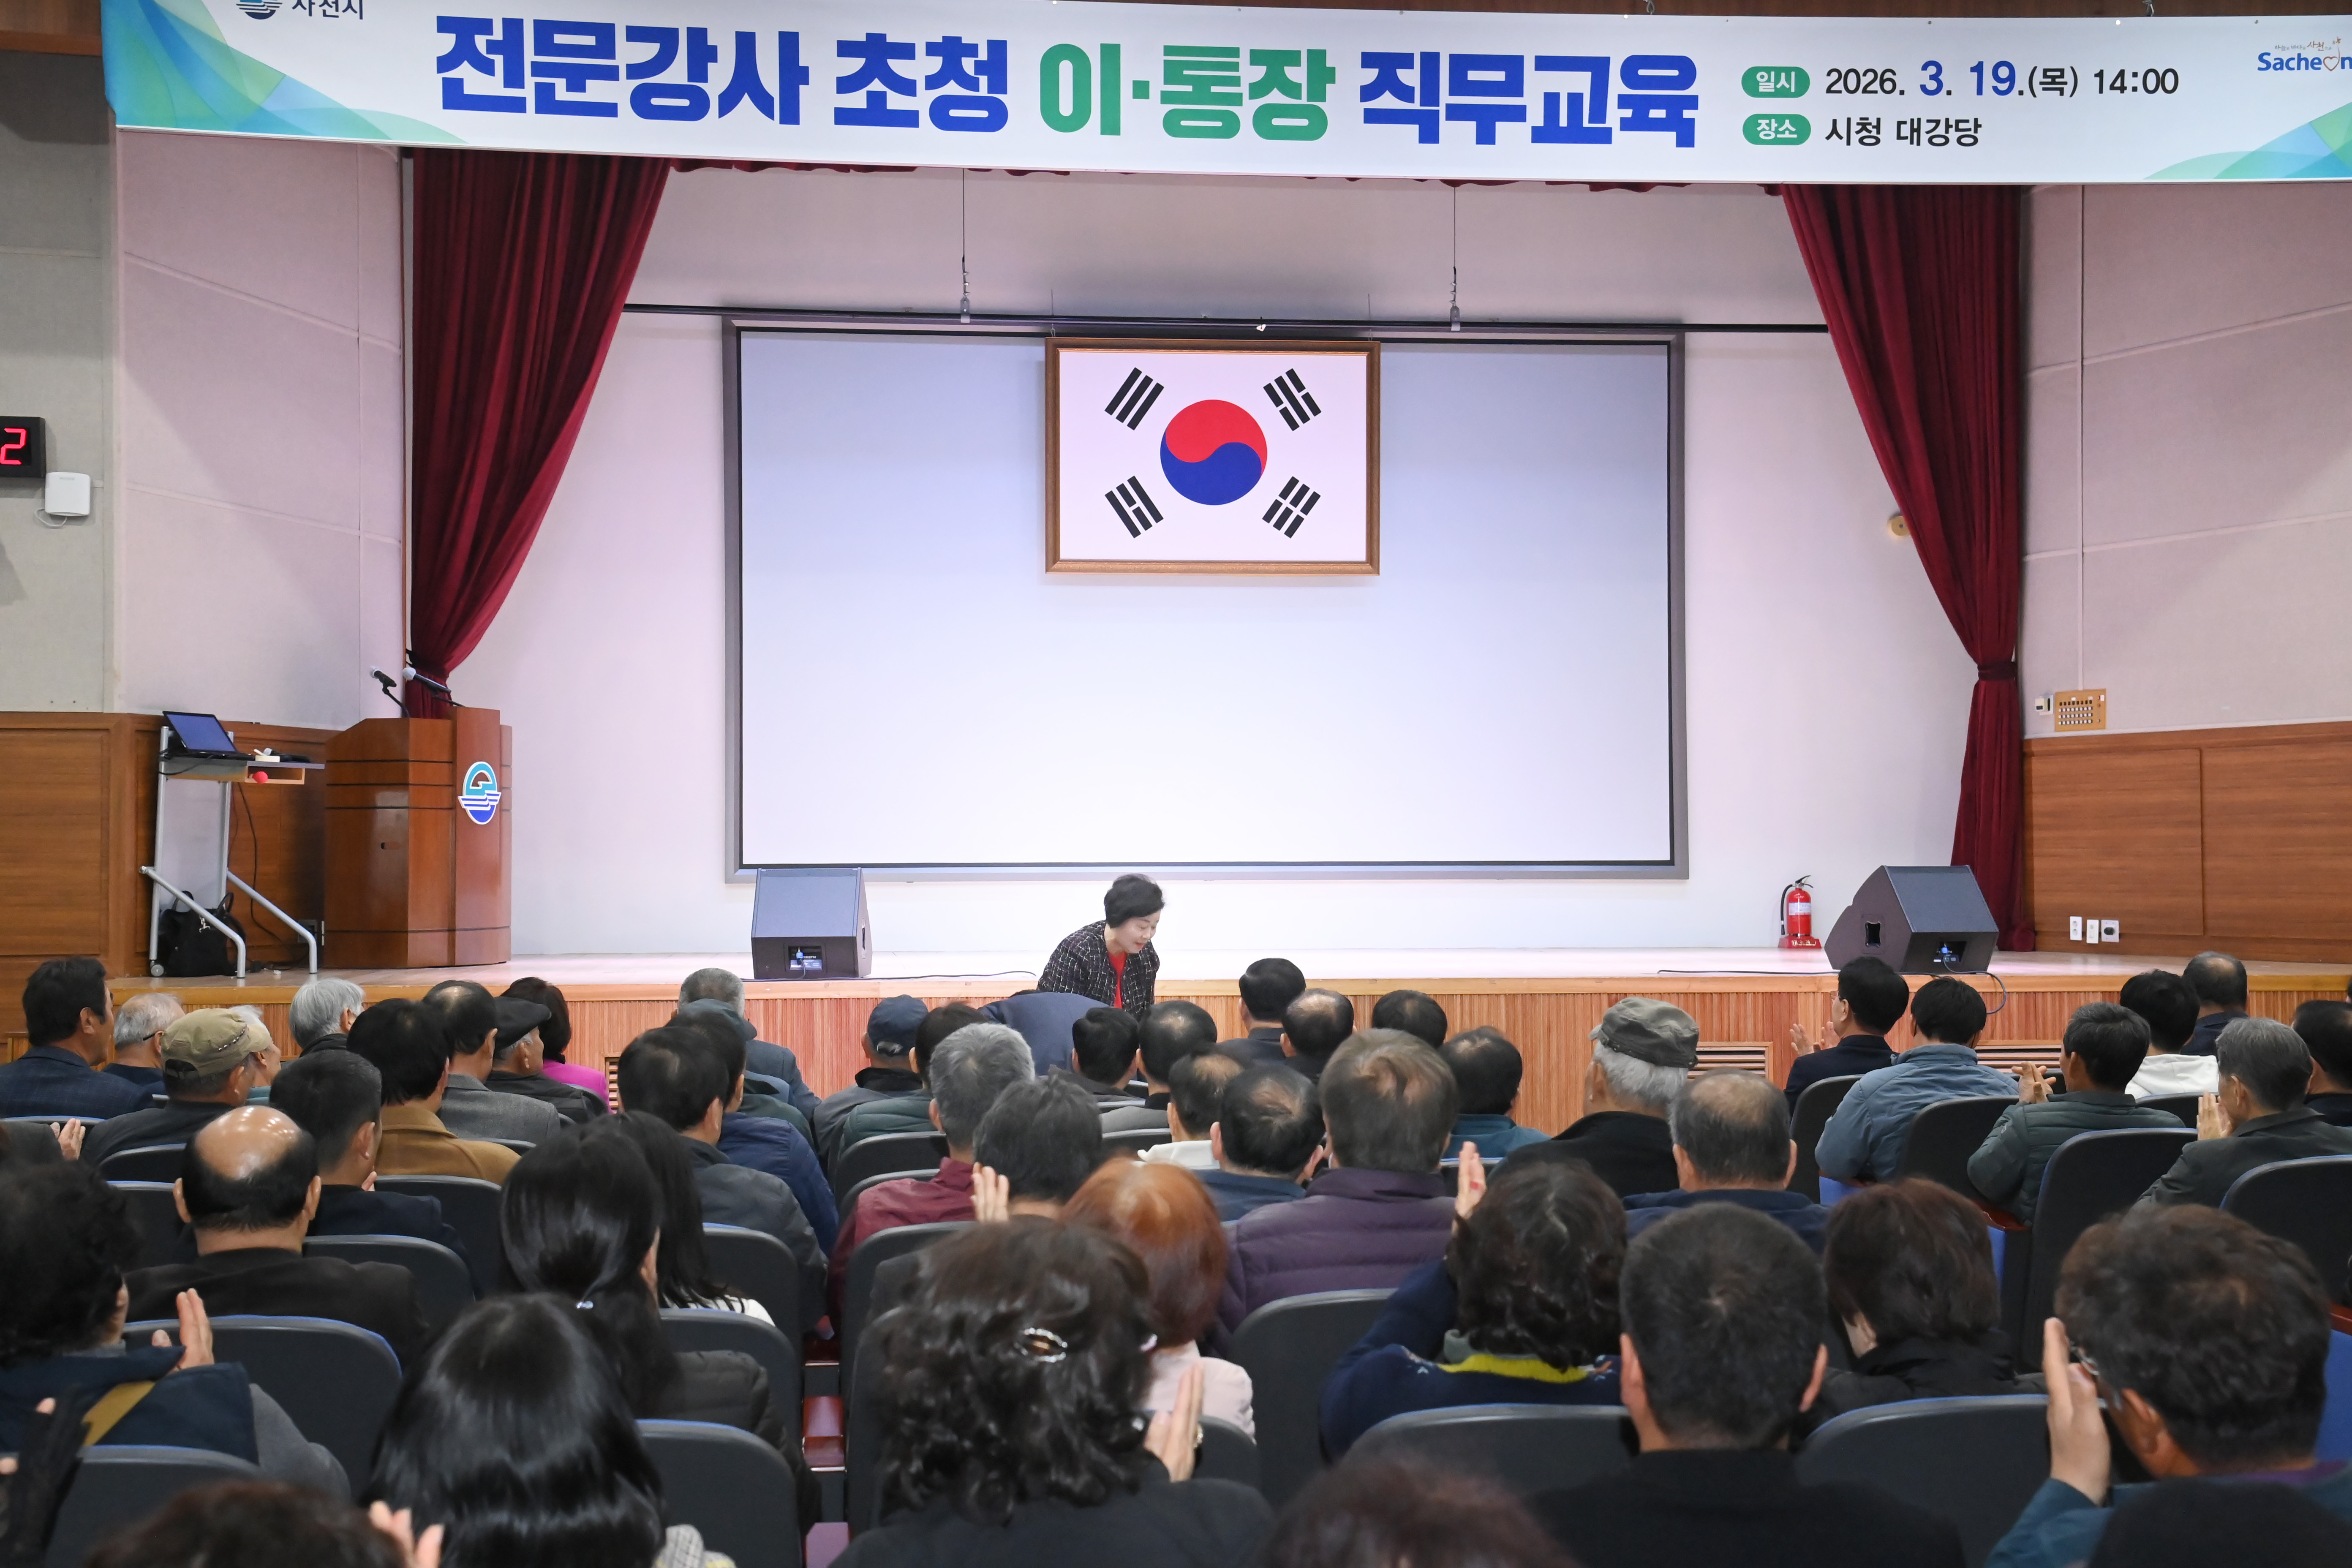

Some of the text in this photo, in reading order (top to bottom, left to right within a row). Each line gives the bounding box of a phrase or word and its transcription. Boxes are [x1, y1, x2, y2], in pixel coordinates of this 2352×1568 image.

[436, 15, 1699, 148] 전문강사 초청 이·통장 직무교육
[1756, 60, 2179, 98] 일시 2026. 3. 19.(목) 14:00
[1756, 117, 1982, 147] 장소 시청 대강당
[0, 427, 27, 465] 2
